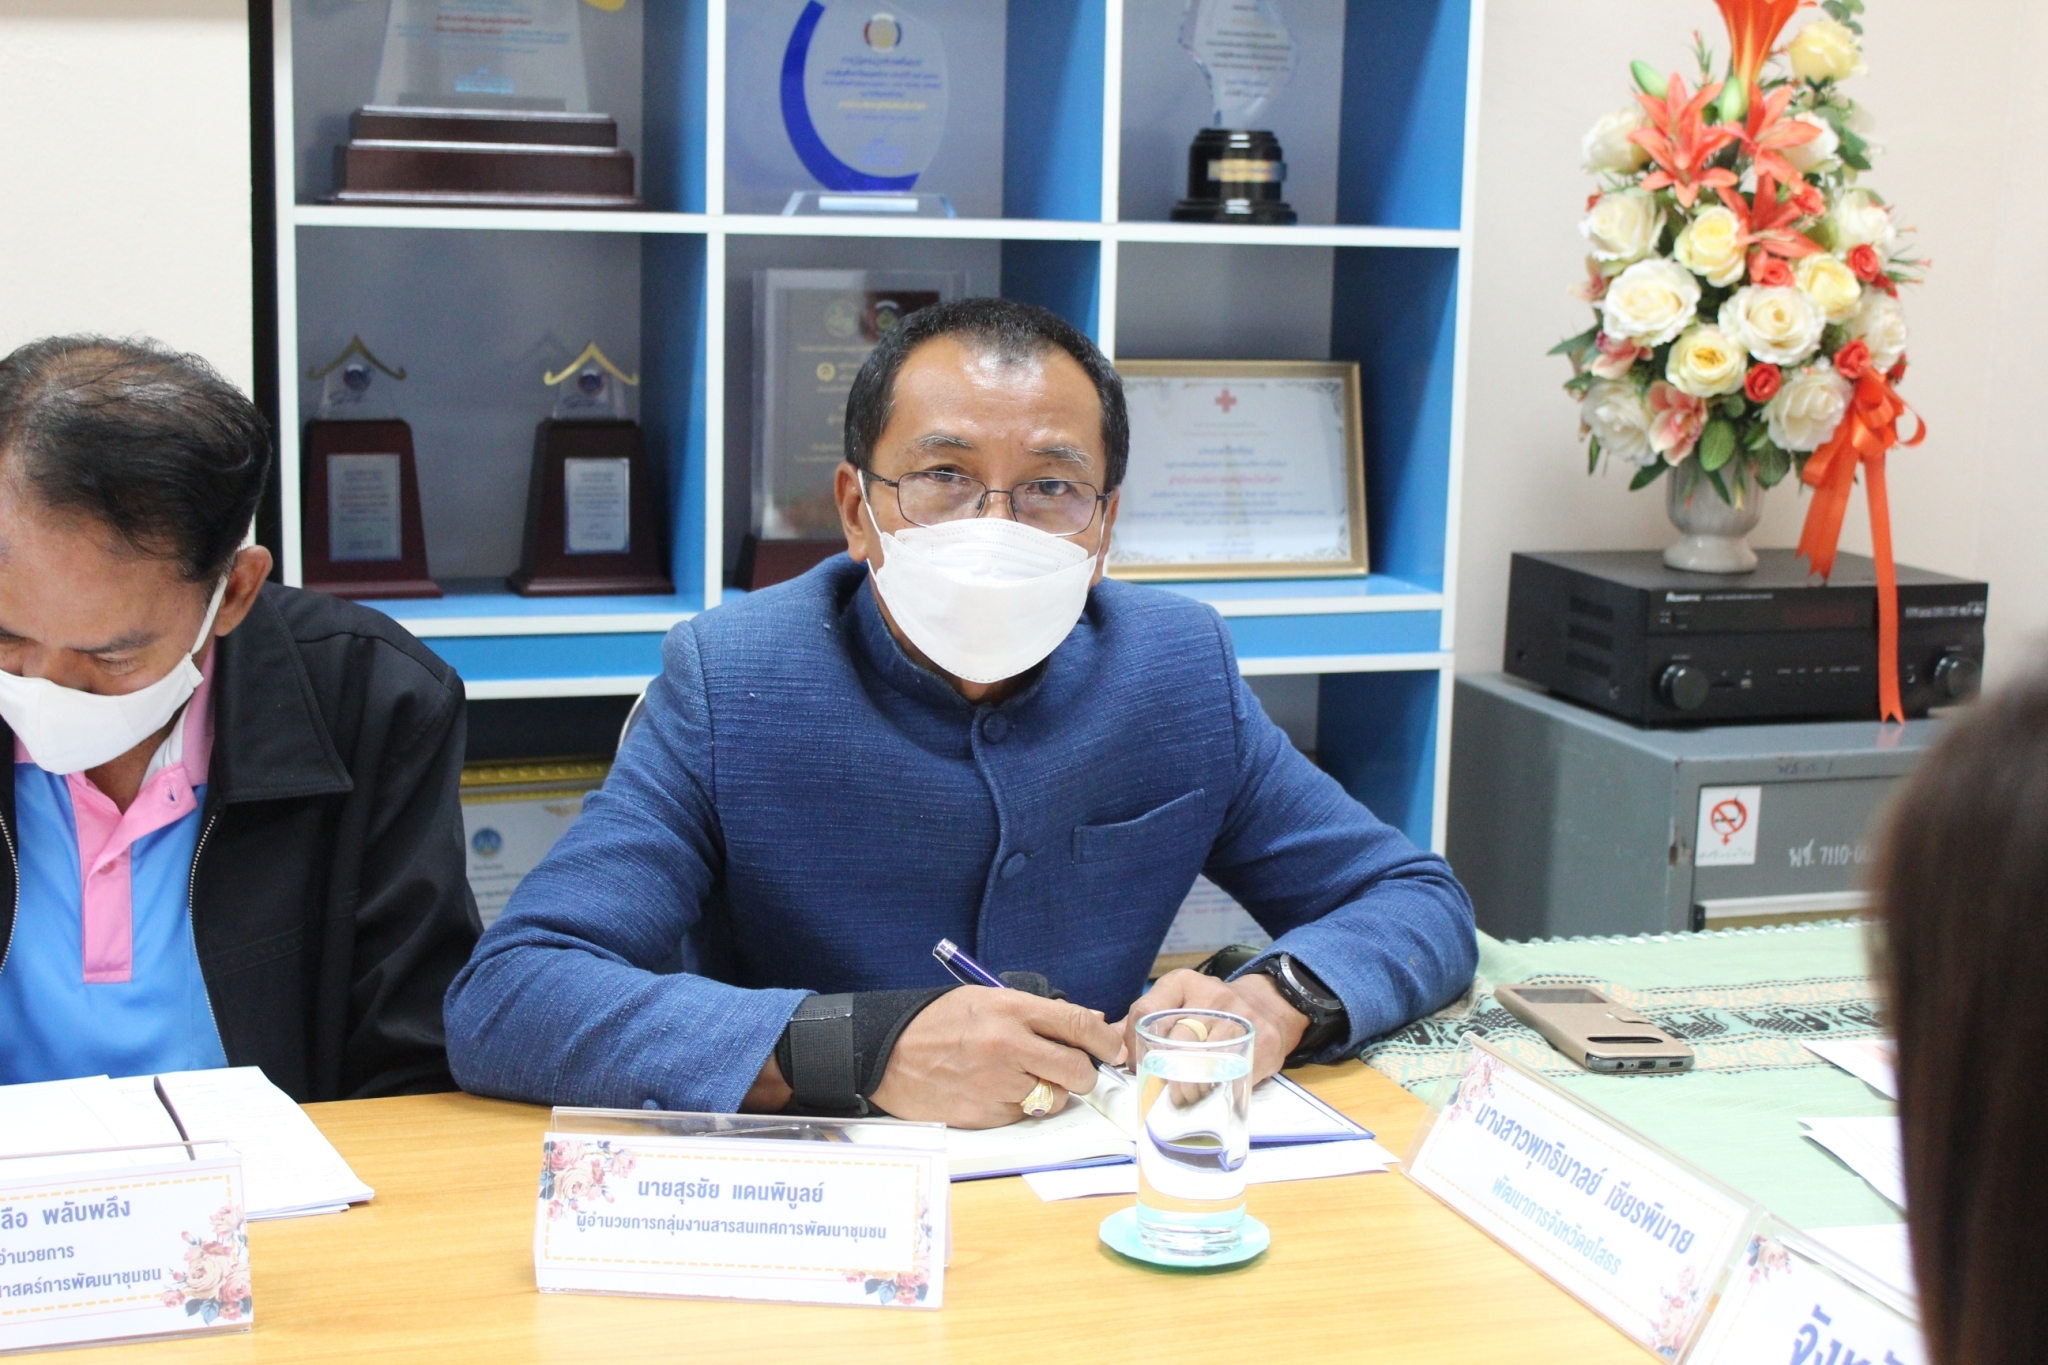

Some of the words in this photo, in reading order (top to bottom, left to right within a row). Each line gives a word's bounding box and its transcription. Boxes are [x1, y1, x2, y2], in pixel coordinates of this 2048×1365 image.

[1474, 1103, 1608, 1196] นางสาวพุทธิมาลย์
[638, 1177, 720, 1205] นายสุรชัย
[732, 1181, 825, 1210] แดนพิบูลย์
[42, 1195, 131, 1226] พลับพลึง
[576, 1210, 887, 1243] ผู้อำนวยการกลุ่มงานสารสนเทศการพัฒนาชุมชน
[1491, 1174, 1622, 1276] พัฒนาการจังหวัดยโสธร
